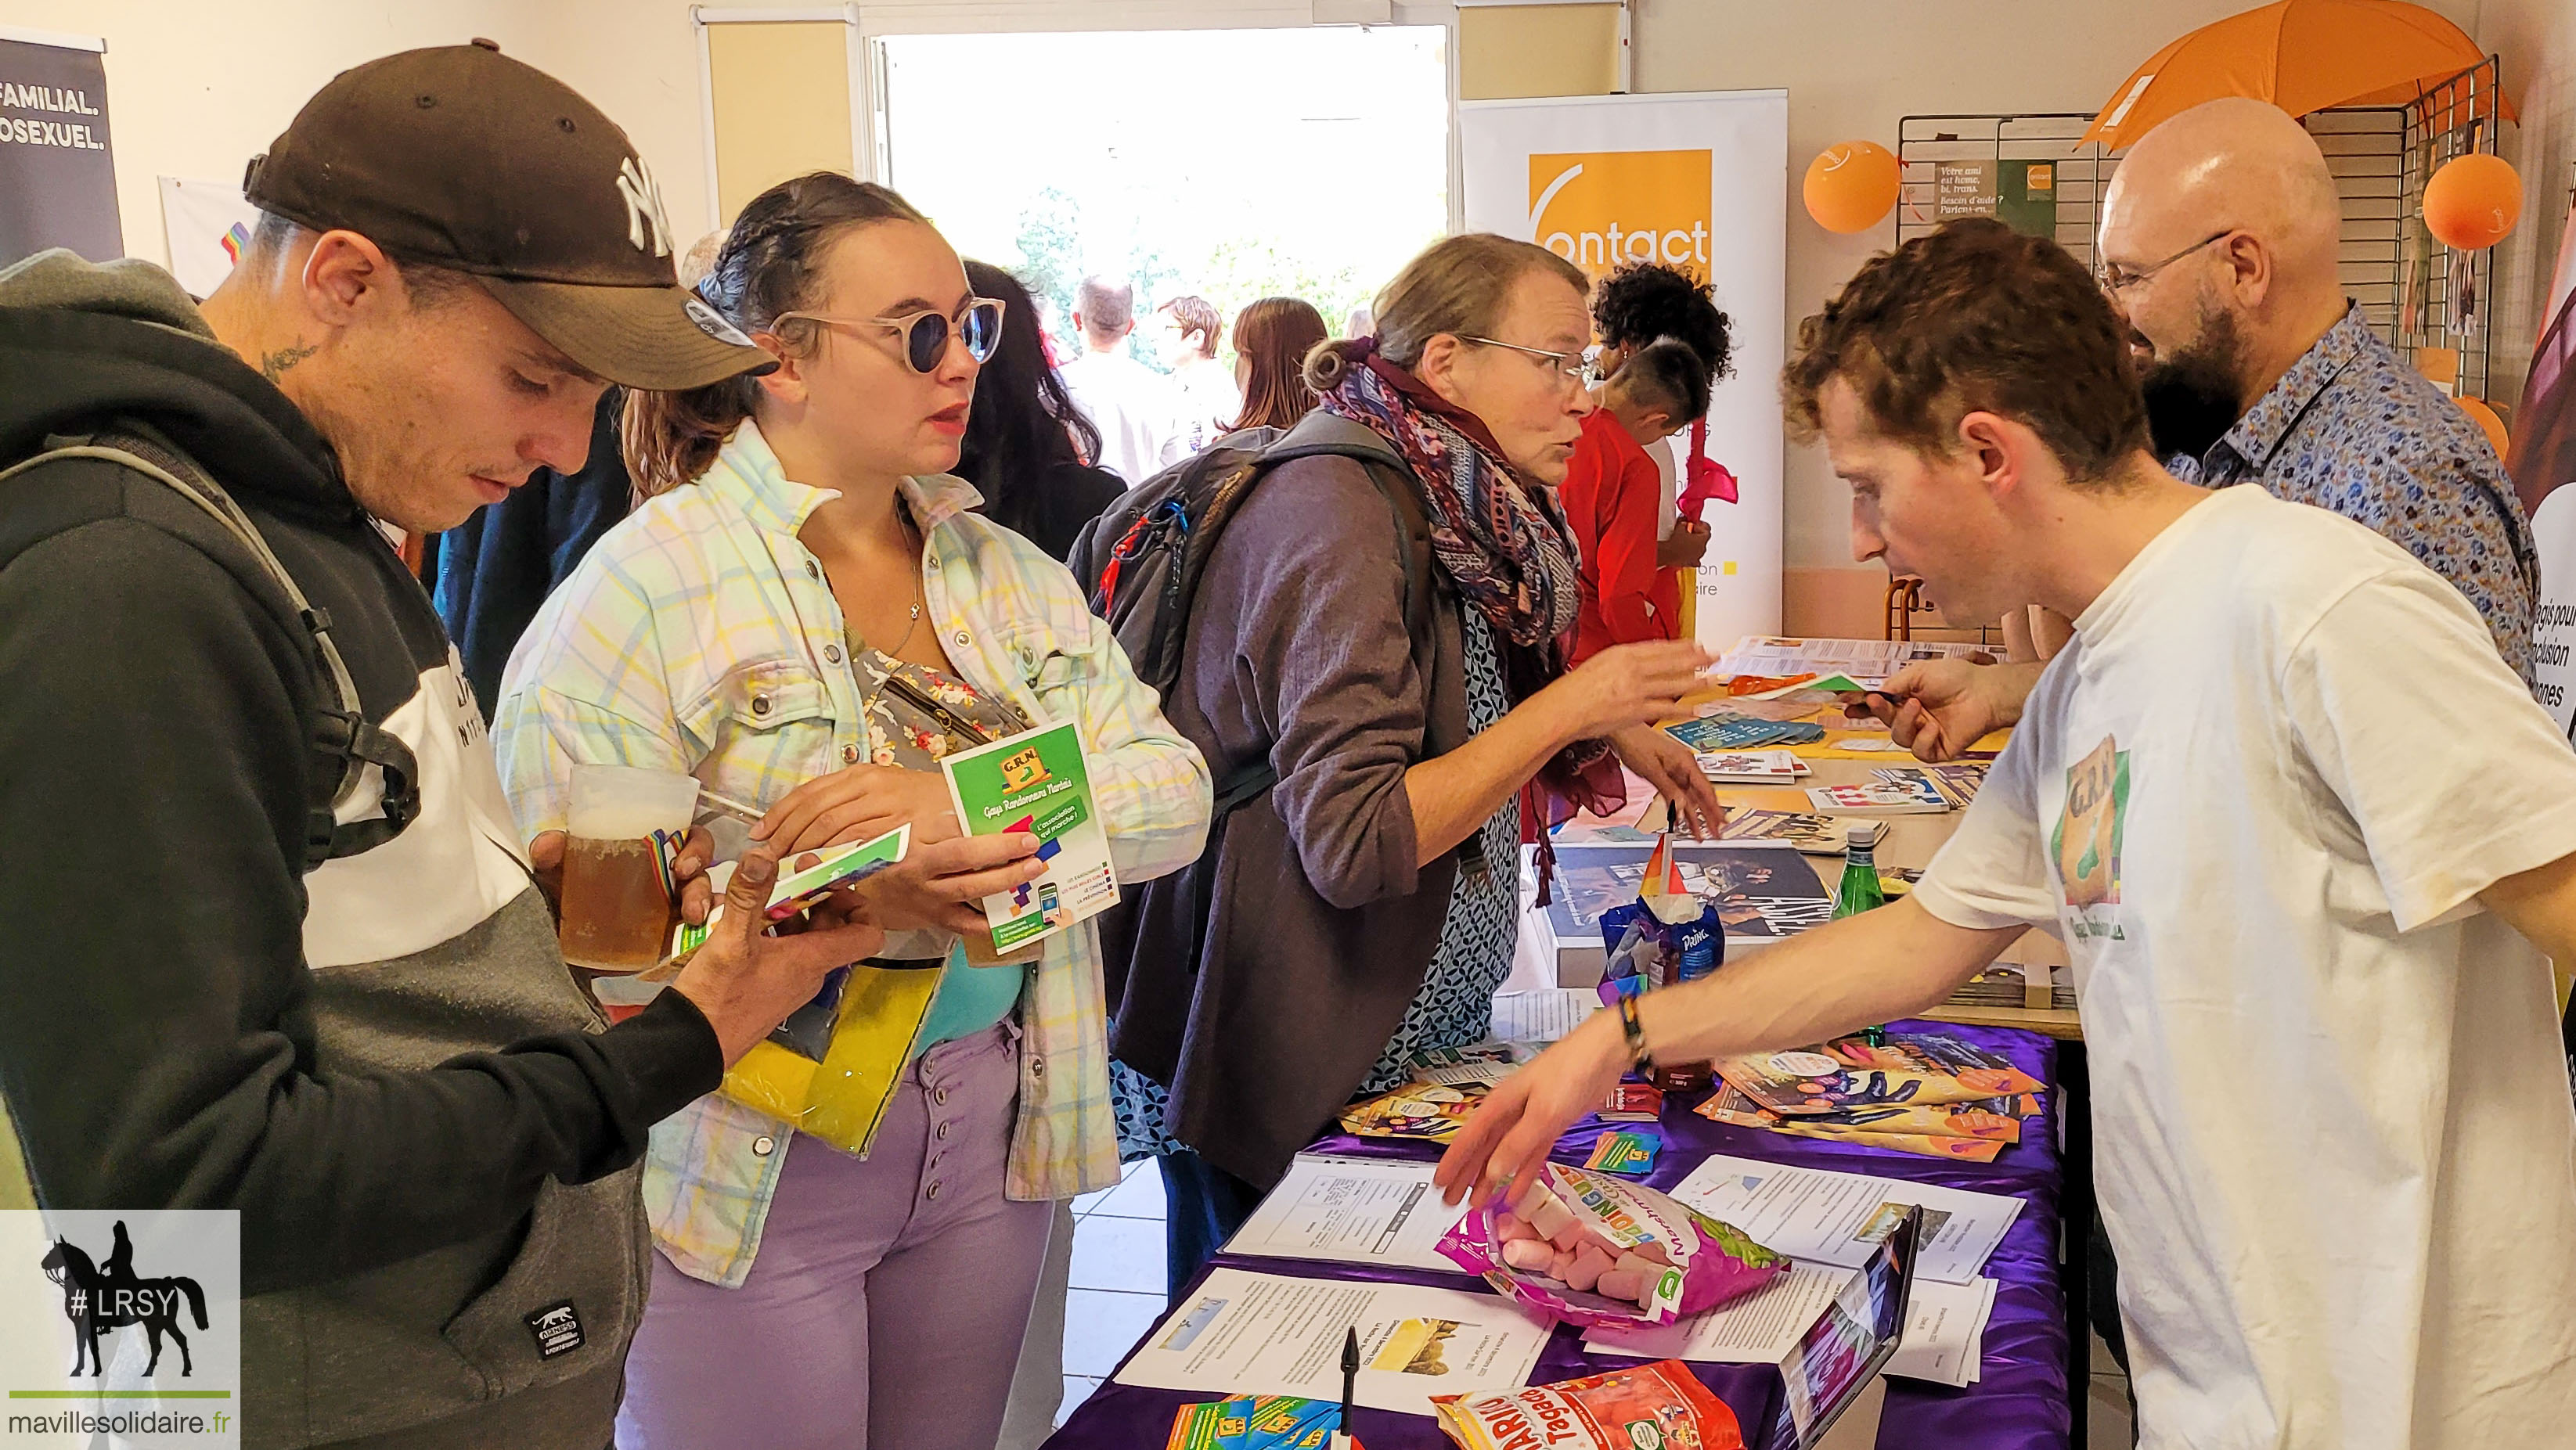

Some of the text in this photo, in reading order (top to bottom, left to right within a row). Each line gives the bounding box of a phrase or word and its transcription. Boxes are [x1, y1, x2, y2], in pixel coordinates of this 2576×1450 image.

[1940, 166, 1982, 176] Votre ami
[1955, 176, 1980, 185] homo,
[1940, 196, 1967, 205] Besoin
[984, 805, 1004, 819] Gays
[1036, 805, 1075, 832] L'association
[1040, 826, 1051, 839] qui
[1050, 815, 1075, 833] marche
